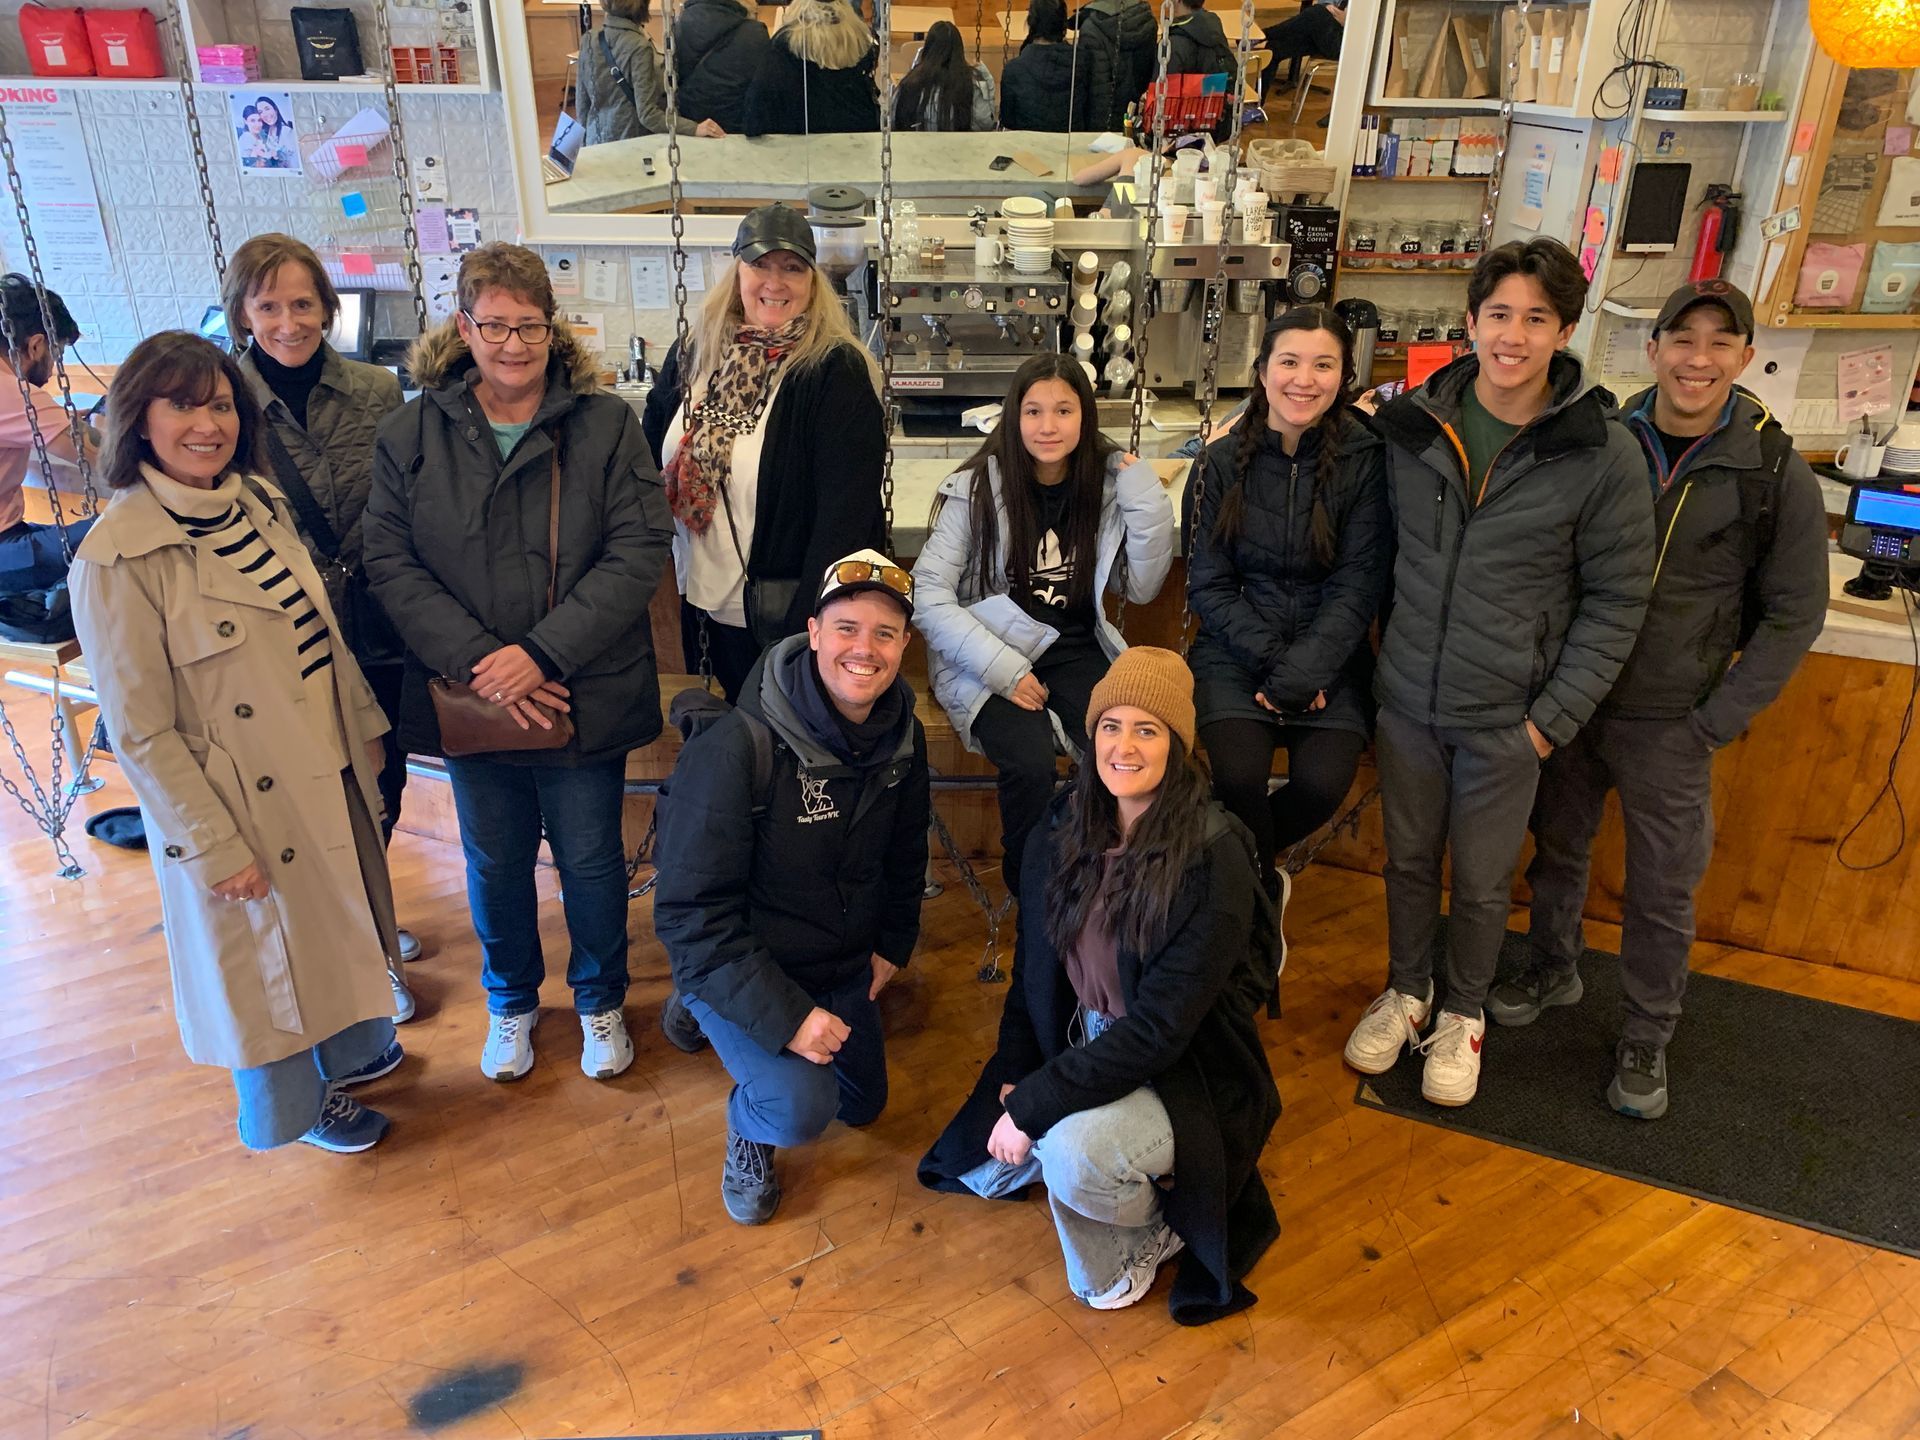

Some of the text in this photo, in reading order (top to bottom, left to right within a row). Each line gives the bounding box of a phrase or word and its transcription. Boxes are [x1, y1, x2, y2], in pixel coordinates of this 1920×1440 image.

[796, 810, 841, 824] Tasty Tours NYC
